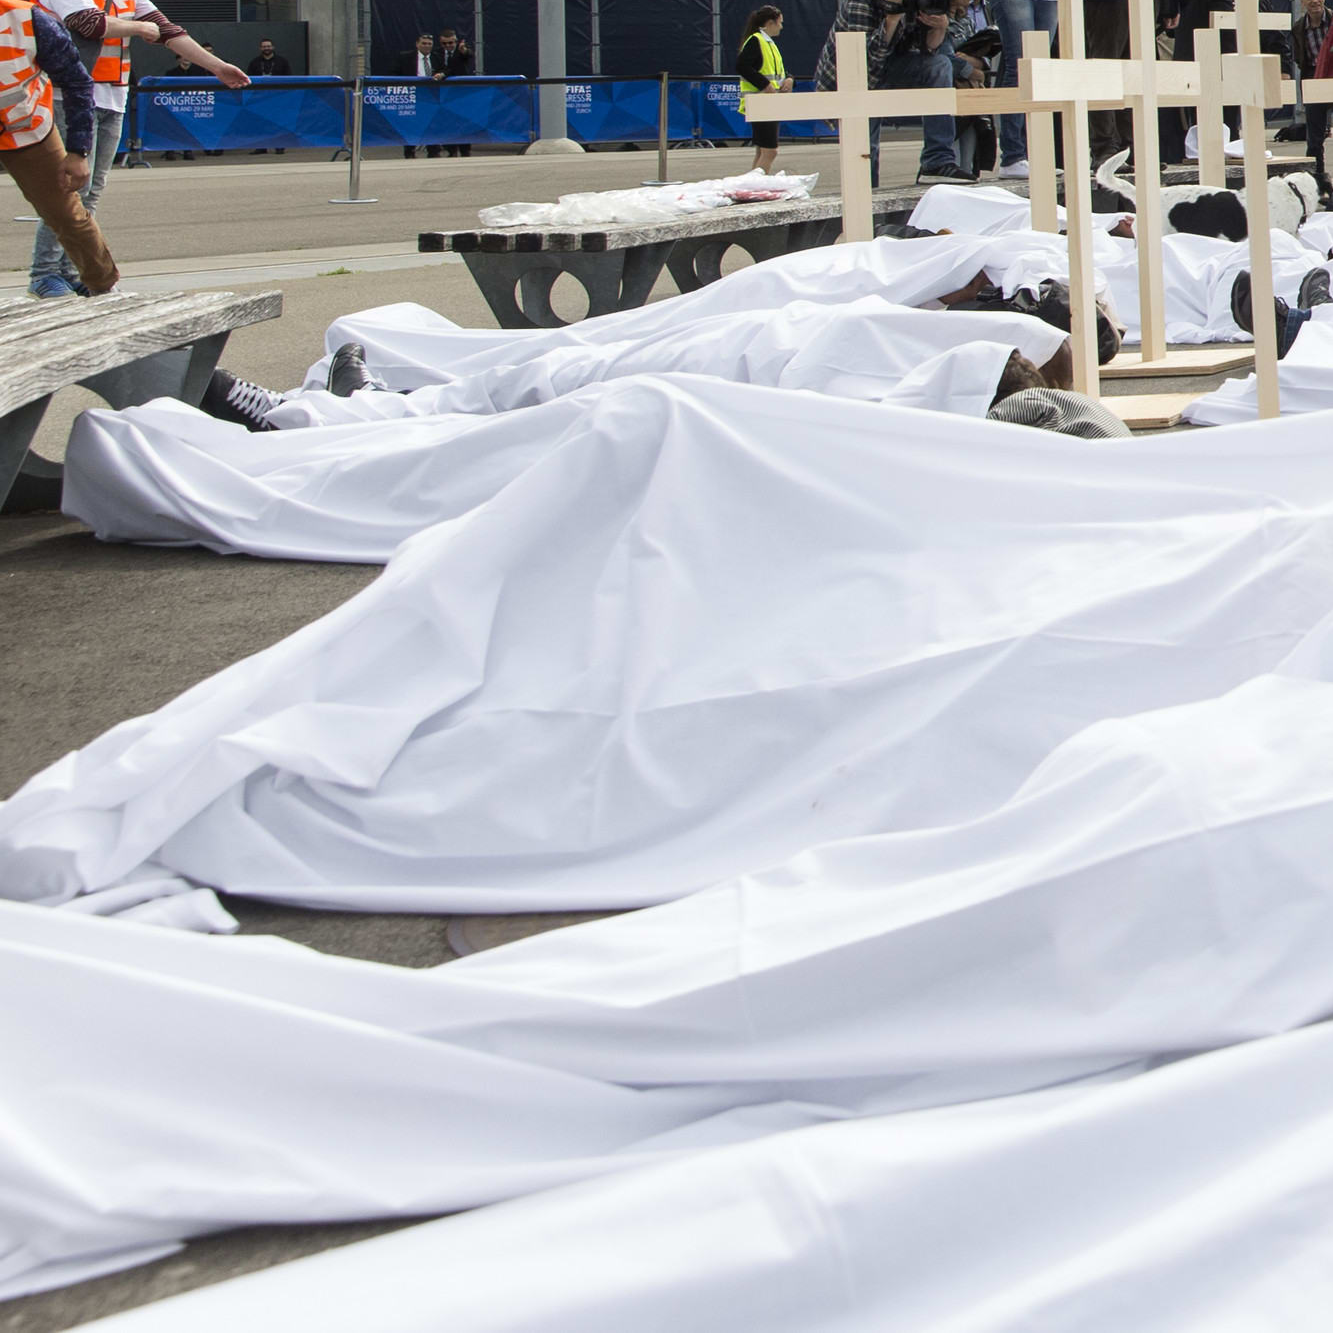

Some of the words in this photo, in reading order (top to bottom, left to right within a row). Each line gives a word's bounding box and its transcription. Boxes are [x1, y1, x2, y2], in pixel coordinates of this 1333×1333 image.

[387, 86, 409, 95] FIFA
[153, 95, 207, 106] CONGRESS
[206, 91, 216, 105] 201
[363, 94, 409, 104] CONGRESS
